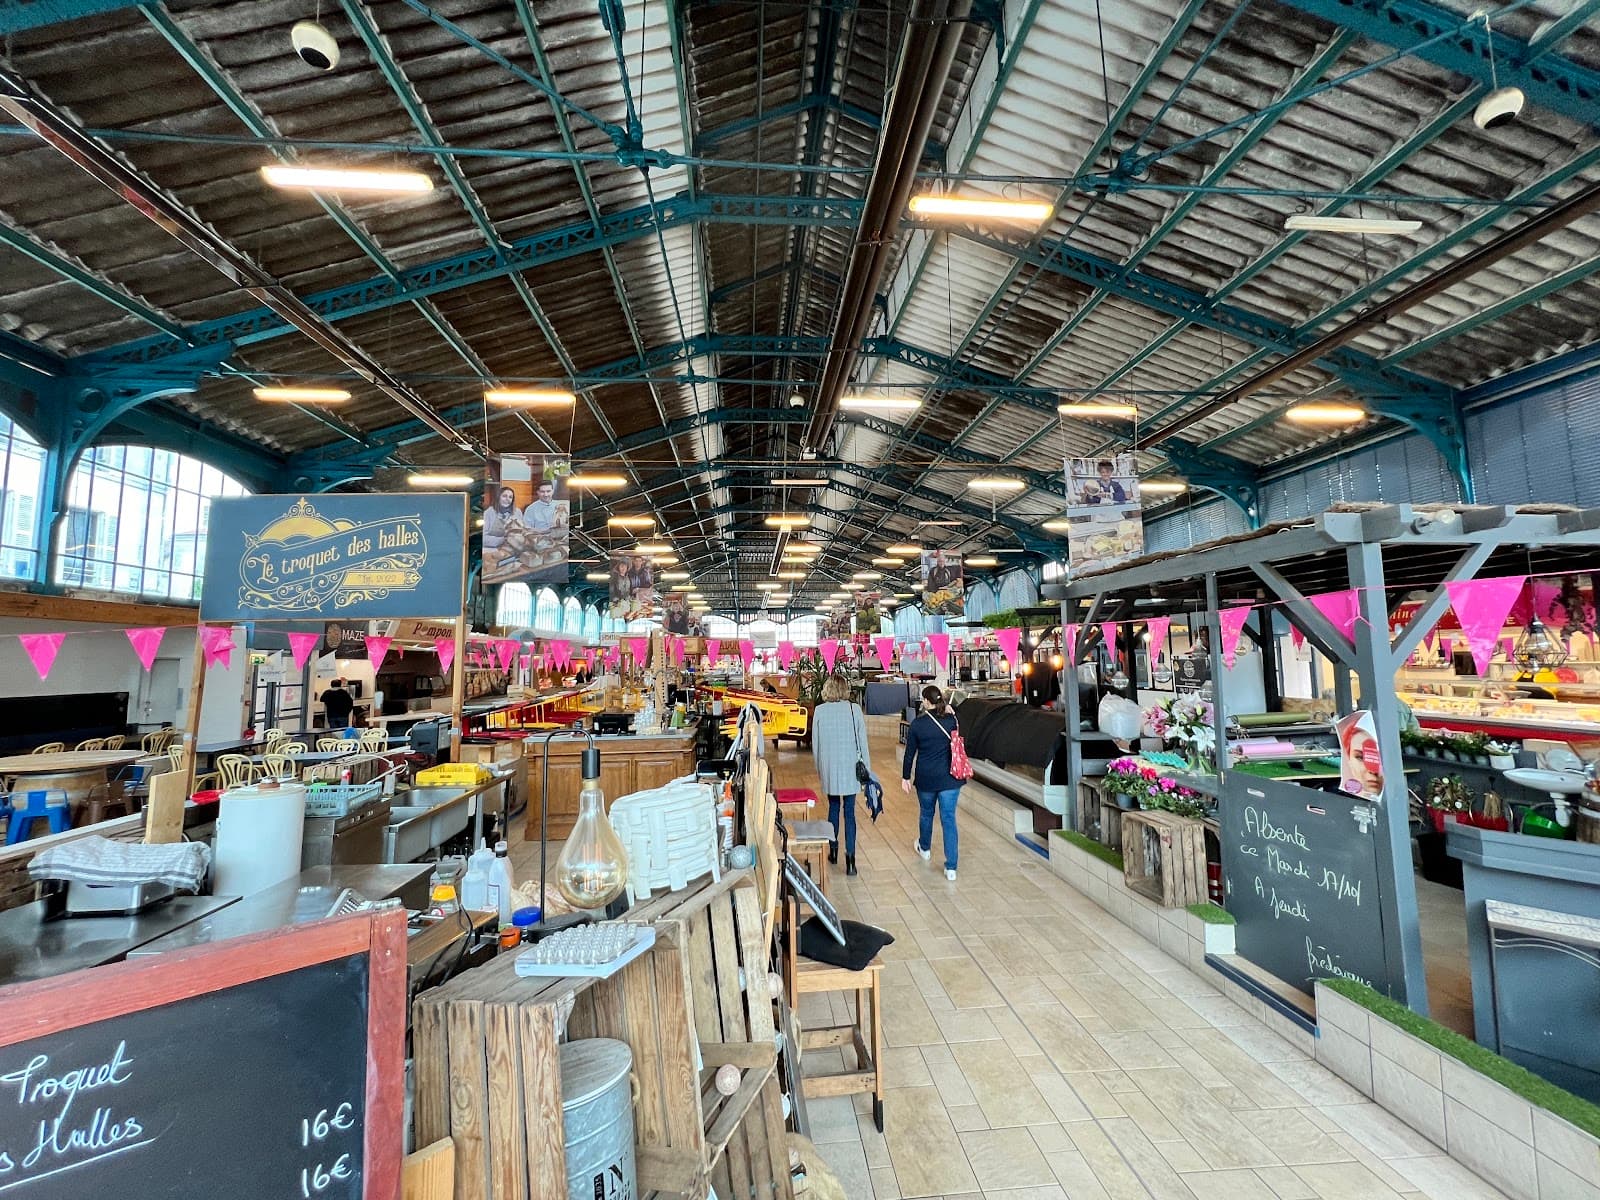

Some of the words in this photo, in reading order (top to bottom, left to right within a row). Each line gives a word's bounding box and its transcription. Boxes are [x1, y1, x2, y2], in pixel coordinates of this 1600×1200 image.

[247, 553, 280, 585] Le
[281, 545, 340, 575] troquet
[347, 535, 372, 557] des
[378, 524, 419, 550] halles
[1244, 806, 1311, 851] Absente
[1267, 846, 1310, 879] Mardi
[1254, 875, 1265, 898] A
[0, 1039, 134, 1122] Troquet
[21, 1107, 143, 1168] Halles
[302, 1102, 355, 1147] 16€
[302, 1153, 353, 1198] 16€
